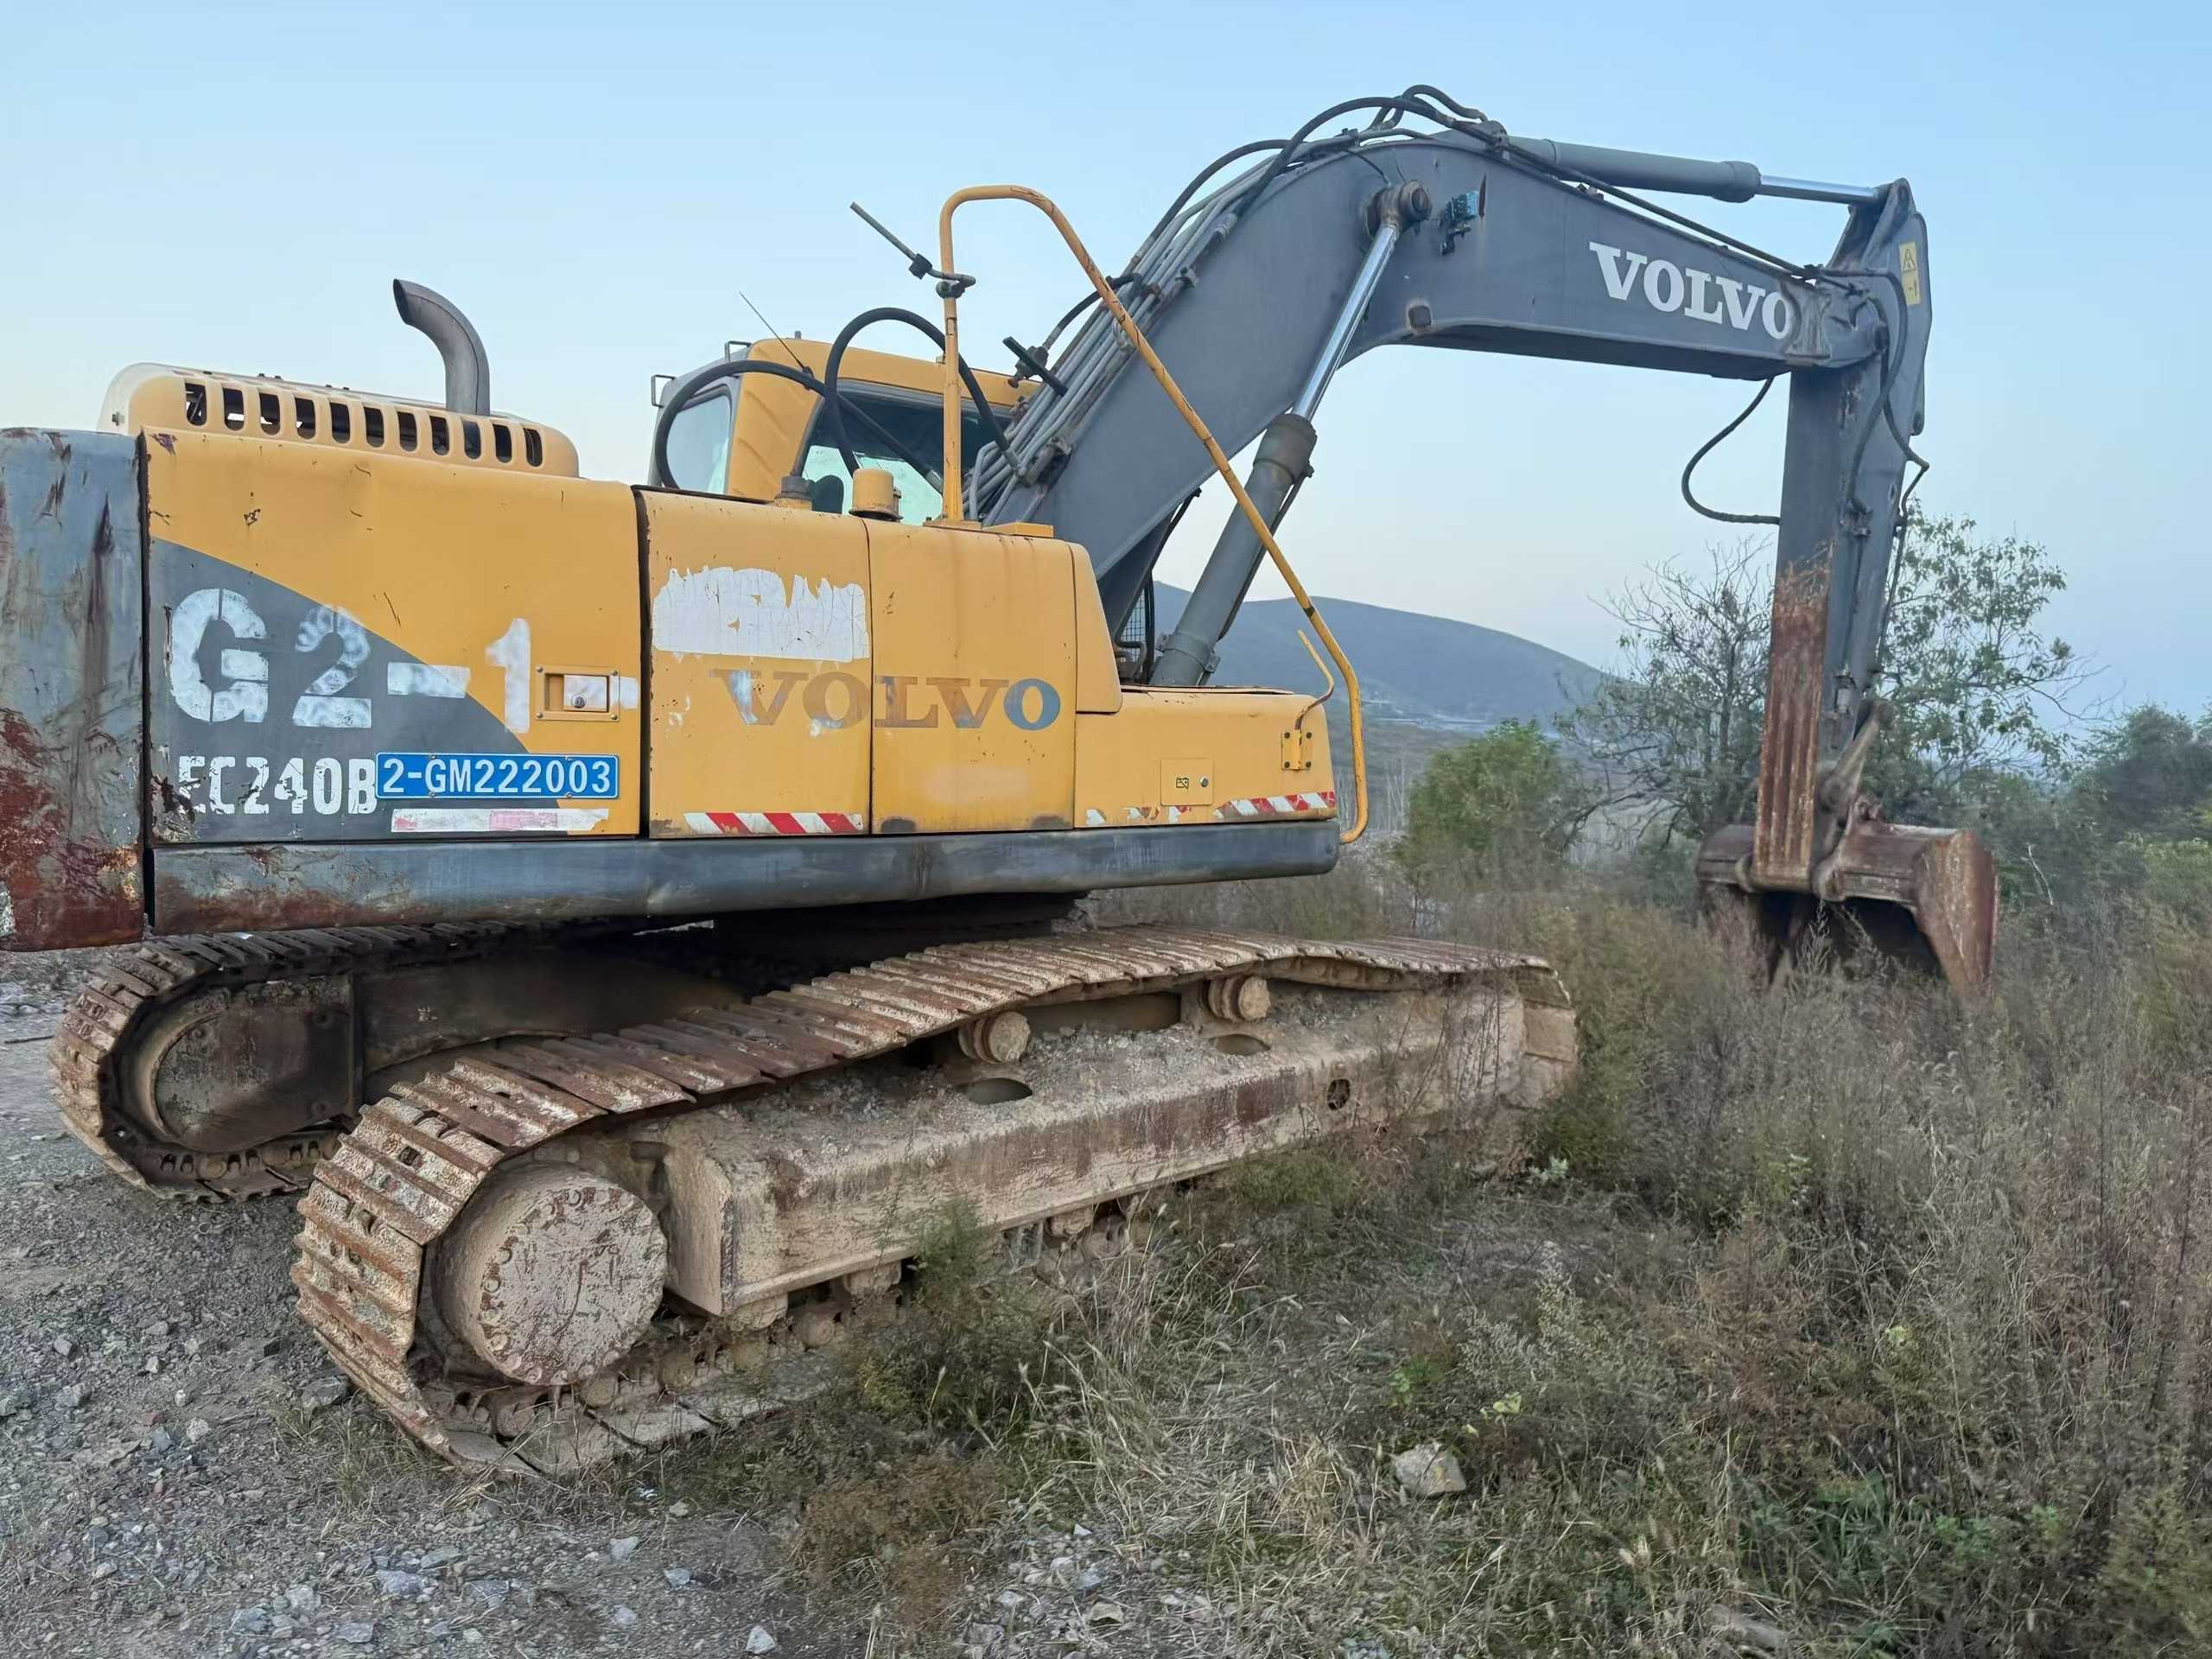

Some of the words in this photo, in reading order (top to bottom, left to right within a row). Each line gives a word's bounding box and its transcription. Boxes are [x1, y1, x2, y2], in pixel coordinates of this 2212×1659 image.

[1589, 241, 1797, 340] VOLVO
[709, 668, 1061, 731] VOLVO
[178, 755, 378, 815] EC240B
[383, 757, 612, 794] 2-GM222003
